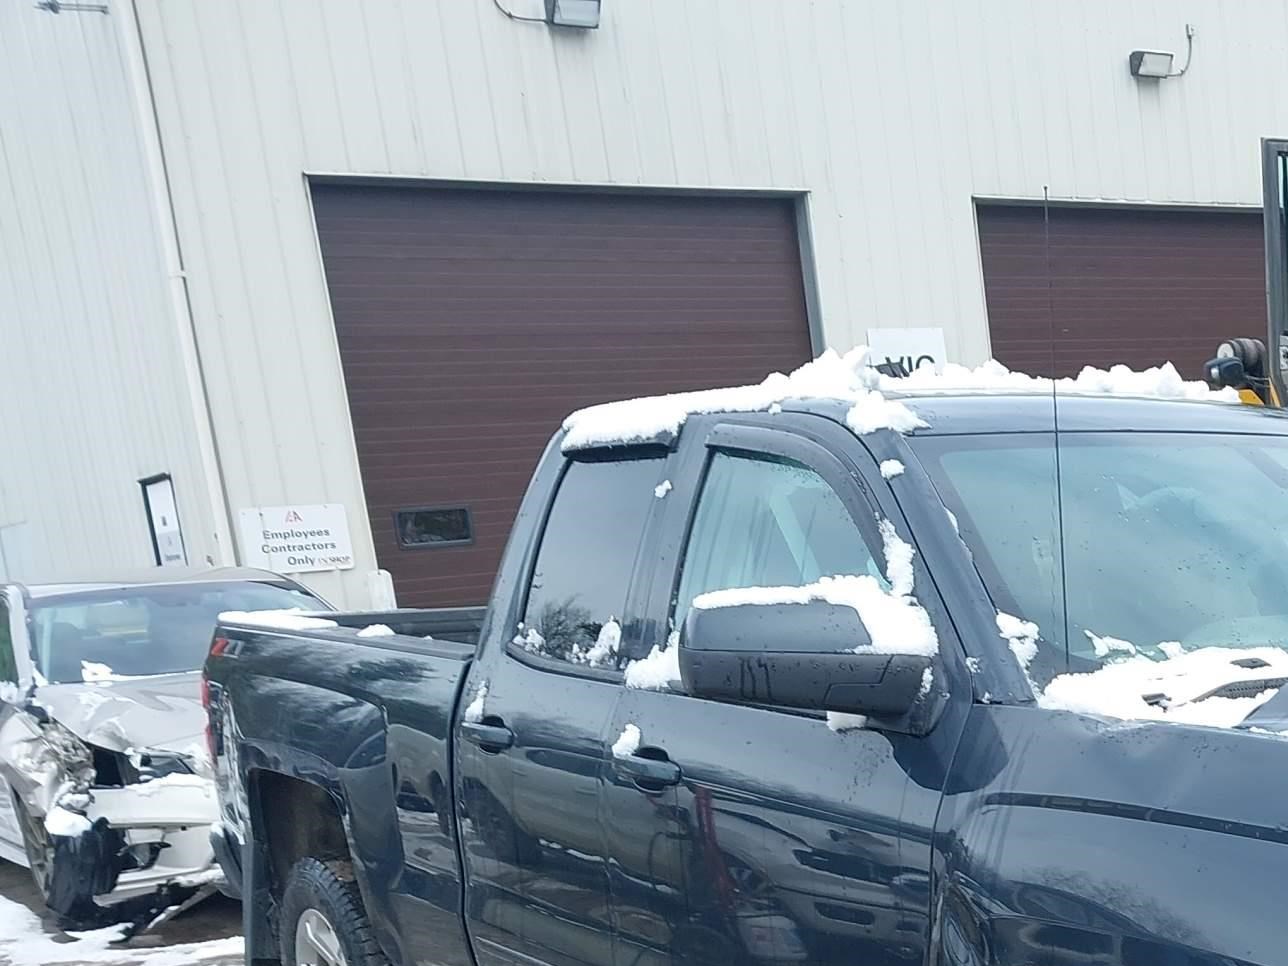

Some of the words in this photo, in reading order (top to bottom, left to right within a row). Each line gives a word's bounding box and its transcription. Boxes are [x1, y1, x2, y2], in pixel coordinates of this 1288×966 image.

[262, 528, 330, 540] Employees
[261, 541, 337, 554] Contractors
[287, 555, 316, 566] Only
